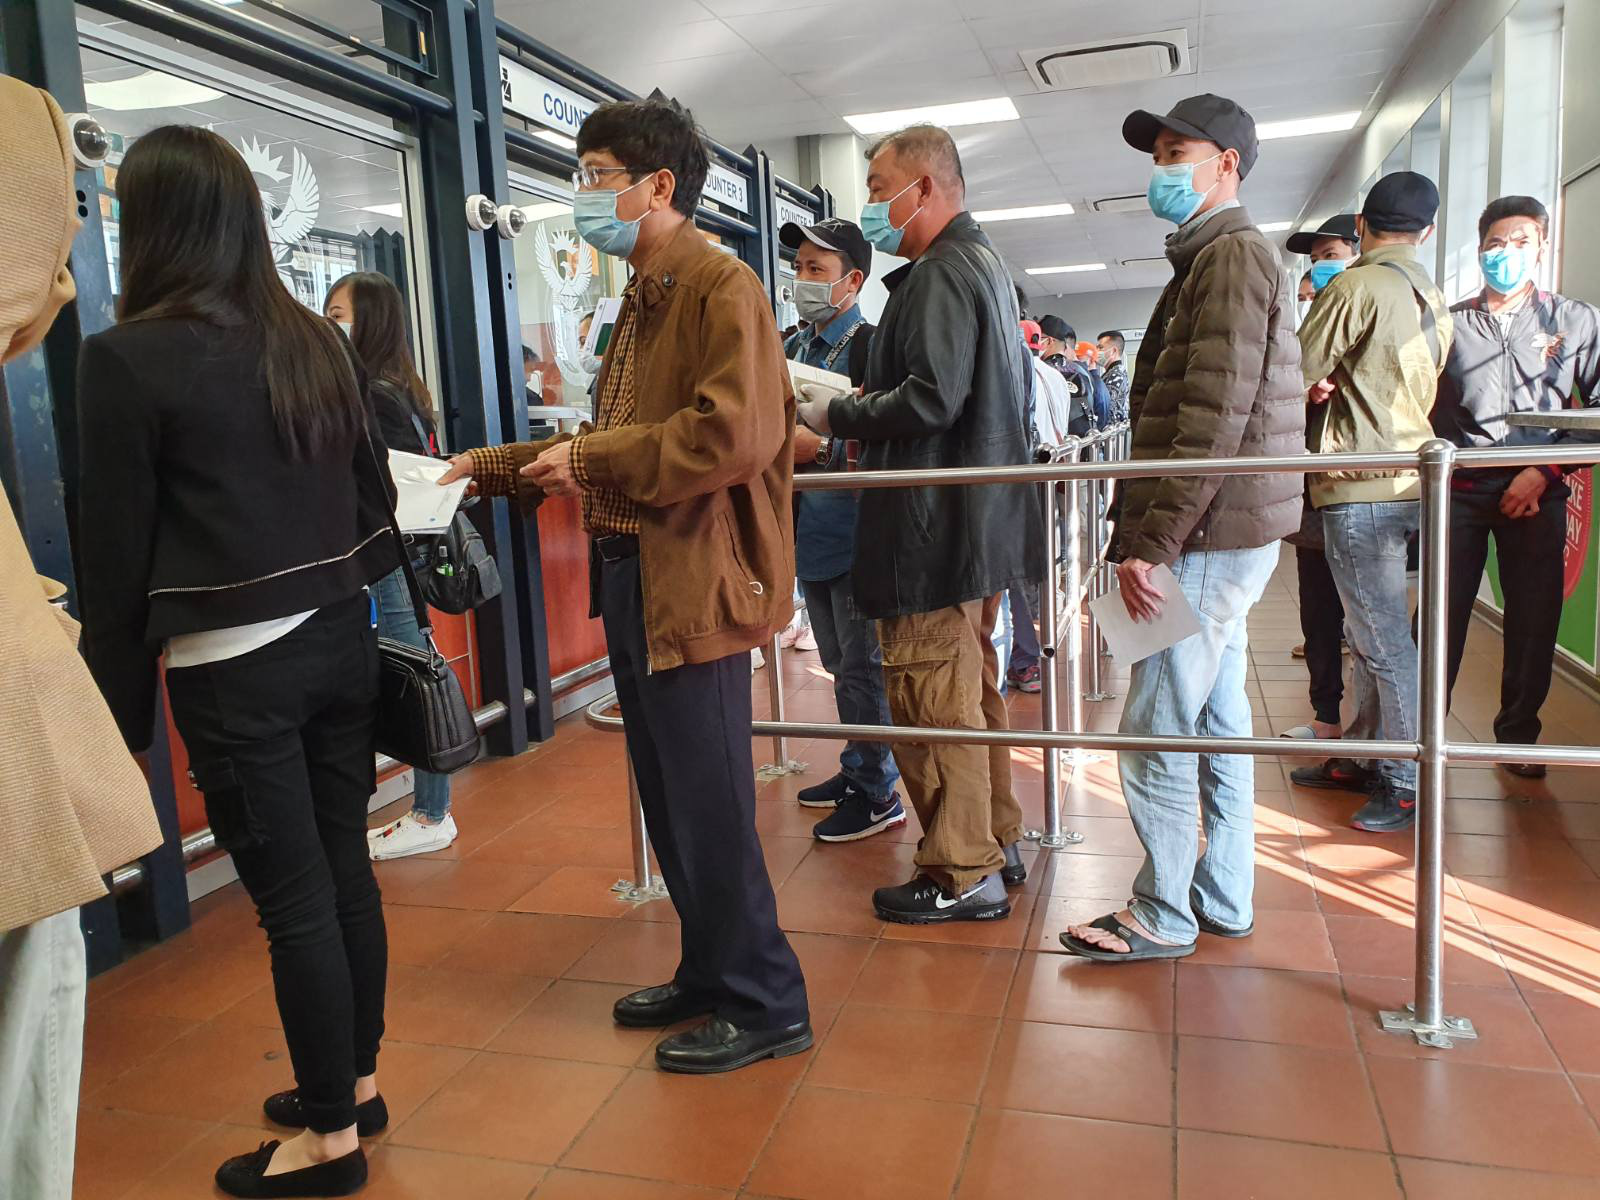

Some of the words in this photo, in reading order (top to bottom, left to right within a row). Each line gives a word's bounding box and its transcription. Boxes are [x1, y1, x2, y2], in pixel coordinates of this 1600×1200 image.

[705, 171, 738, 201] OUNTER
[738, 186, 743, 203] 3
[1566, 511, 1583, 545] AY
